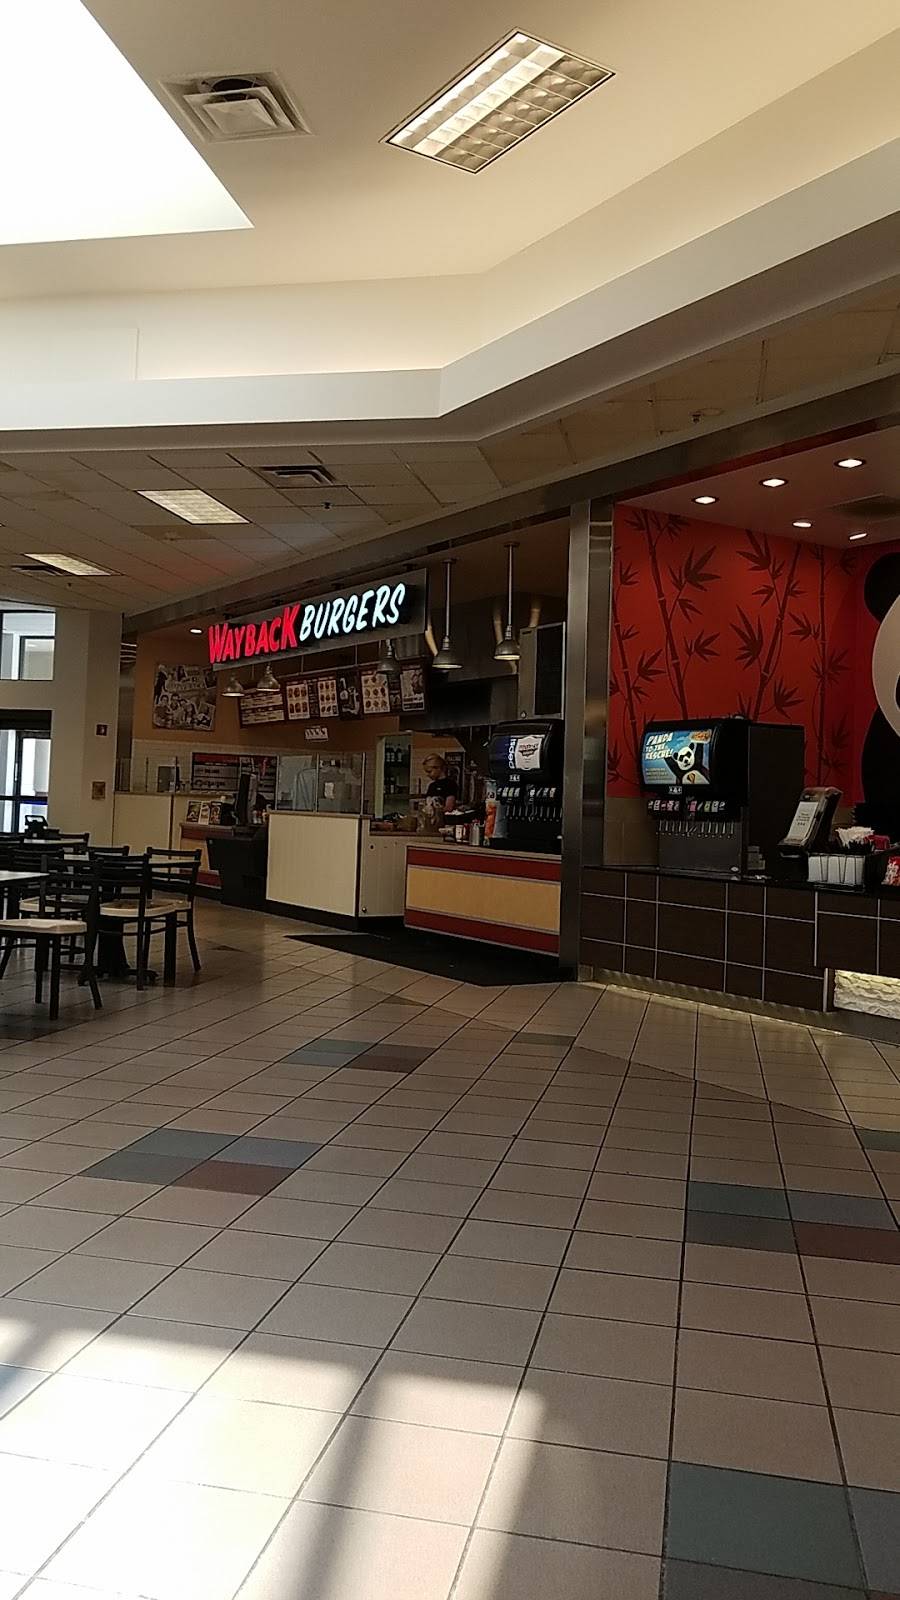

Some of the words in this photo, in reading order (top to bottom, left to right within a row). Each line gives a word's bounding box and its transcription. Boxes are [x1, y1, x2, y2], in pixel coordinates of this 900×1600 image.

[208, 603, 301, 665] WAYBACK
[299, 582, 406, 642] BURGERS
[646, 732, 673, 745] PANDA
